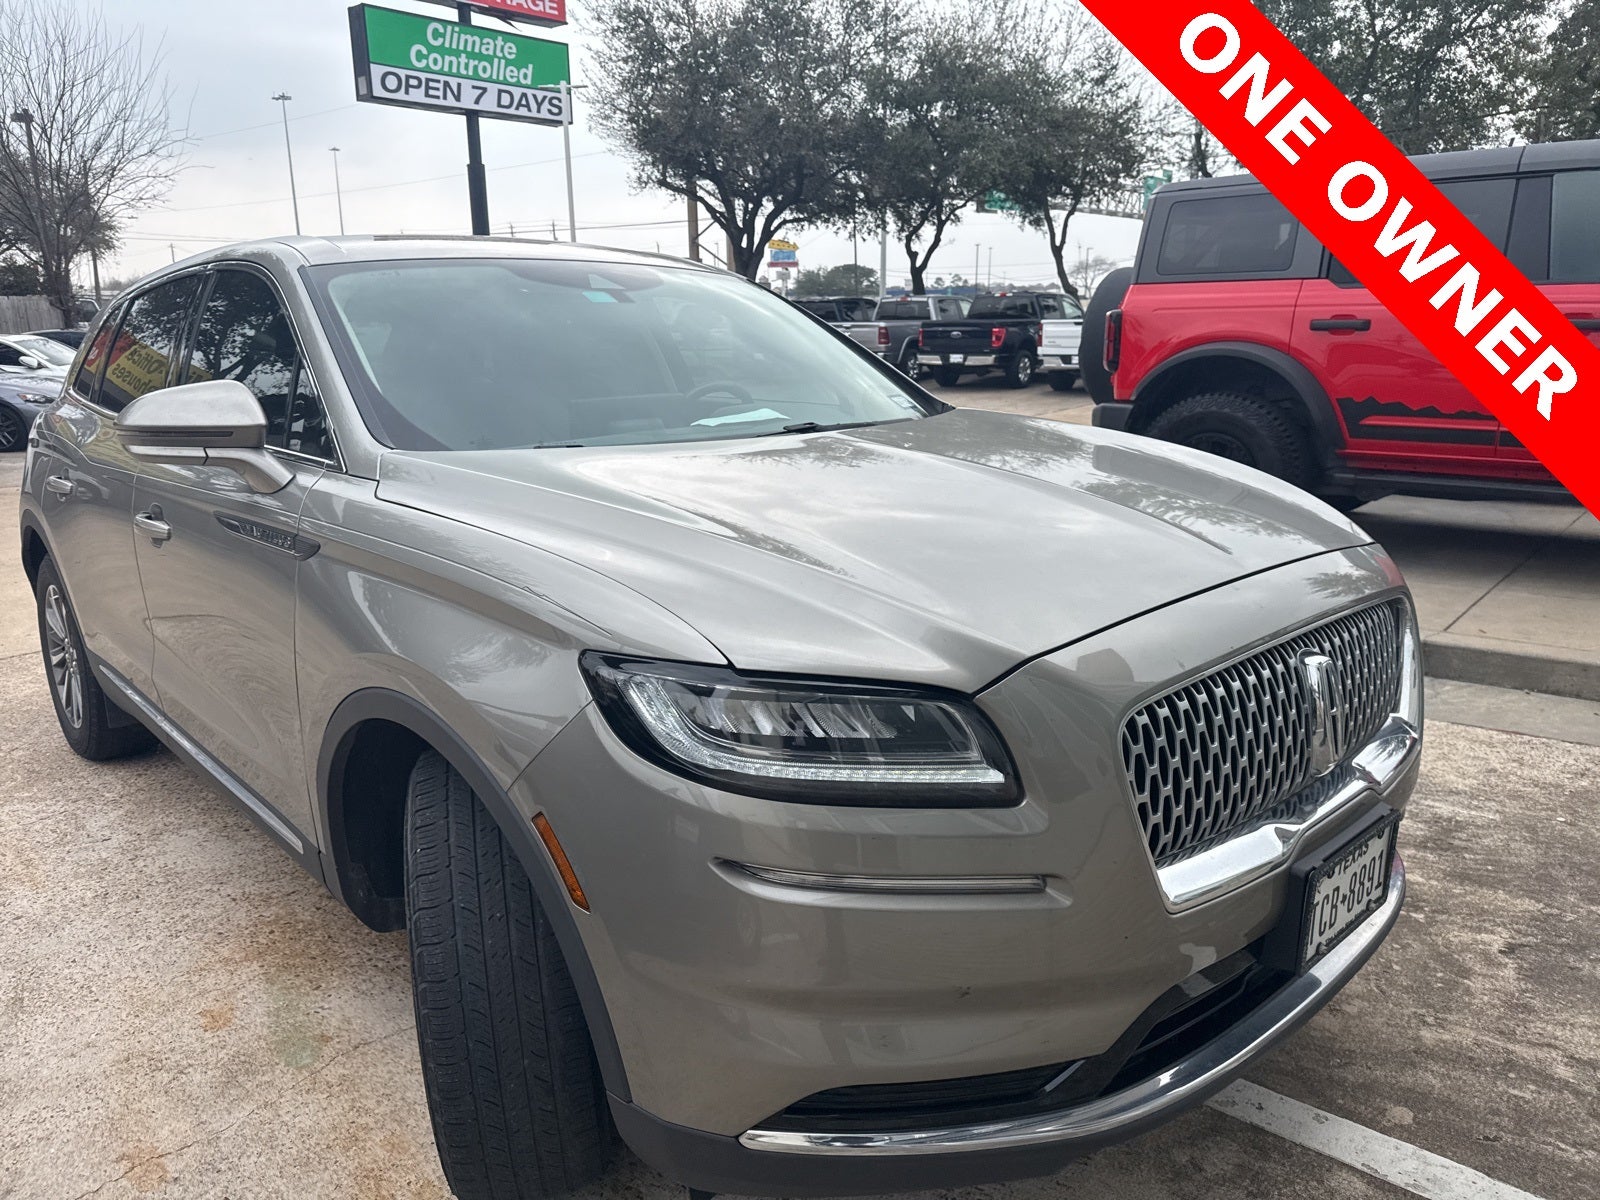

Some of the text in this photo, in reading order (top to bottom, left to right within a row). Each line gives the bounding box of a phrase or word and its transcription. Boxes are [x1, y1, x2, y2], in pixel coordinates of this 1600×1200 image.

[426, 22, 518, 60] Climate
[410, 44, 533, 85] Controlled
[380, 71, 563, 117] OPEN 7 DAYS
